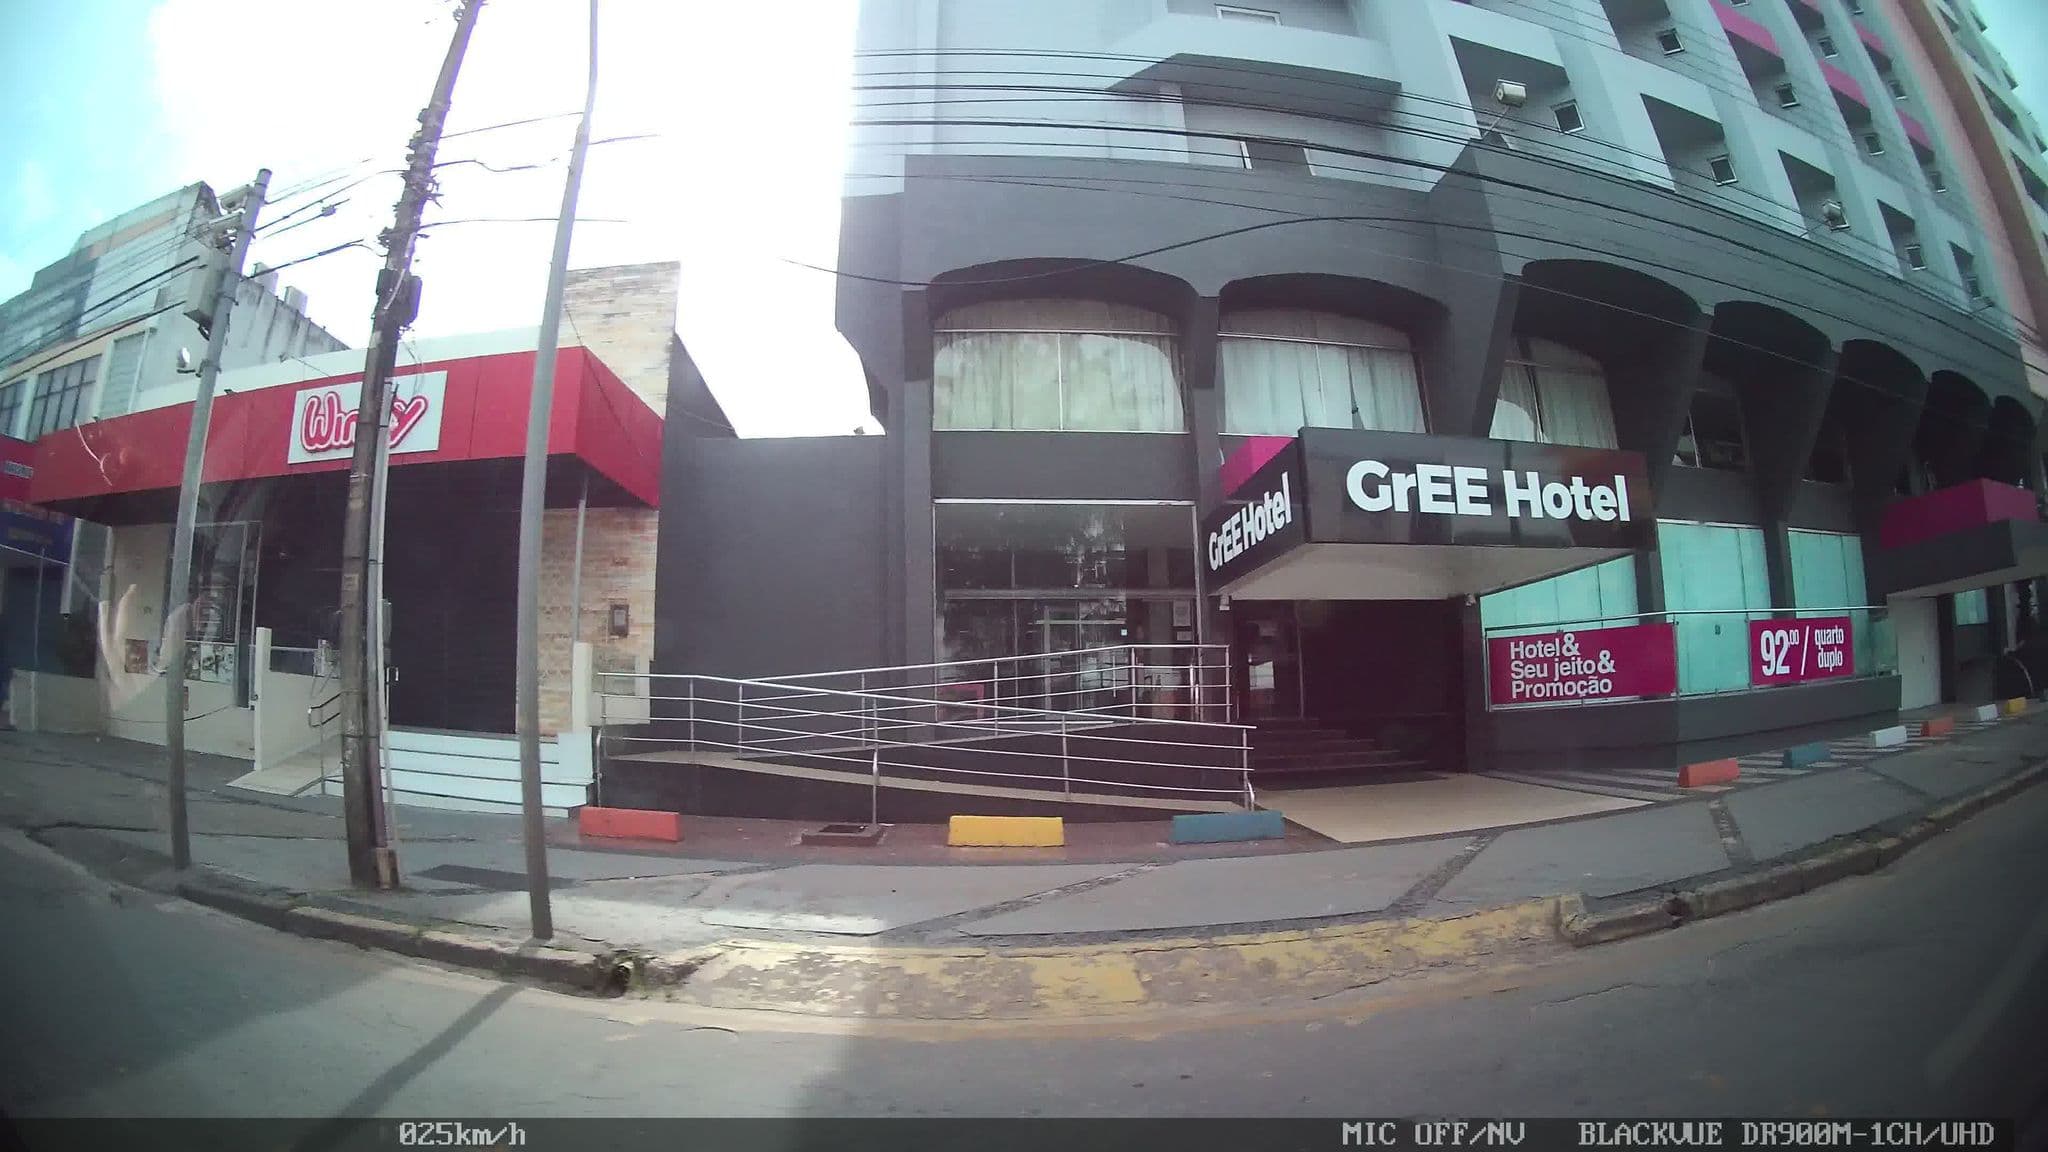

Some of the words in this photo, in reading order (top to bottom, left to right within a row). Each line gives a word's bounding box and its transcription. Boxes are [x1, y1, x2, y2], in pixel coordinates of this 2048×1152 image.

[301, 391, 428, 453] Winy
[1346, 460, 1492, 516] GrEE
[1502, 470, 1630, 522] Hotel
[1208, 511, 1243, 571] GrEE
[1241, 471, 1292, 550] Hotel
[1814, 624, 1844, 650] quarto
[1511, 660, 1548, 680] Seu
[1817, 646, 1843, 672] duplo
[1511, 675, 1612, 699] Promoção
